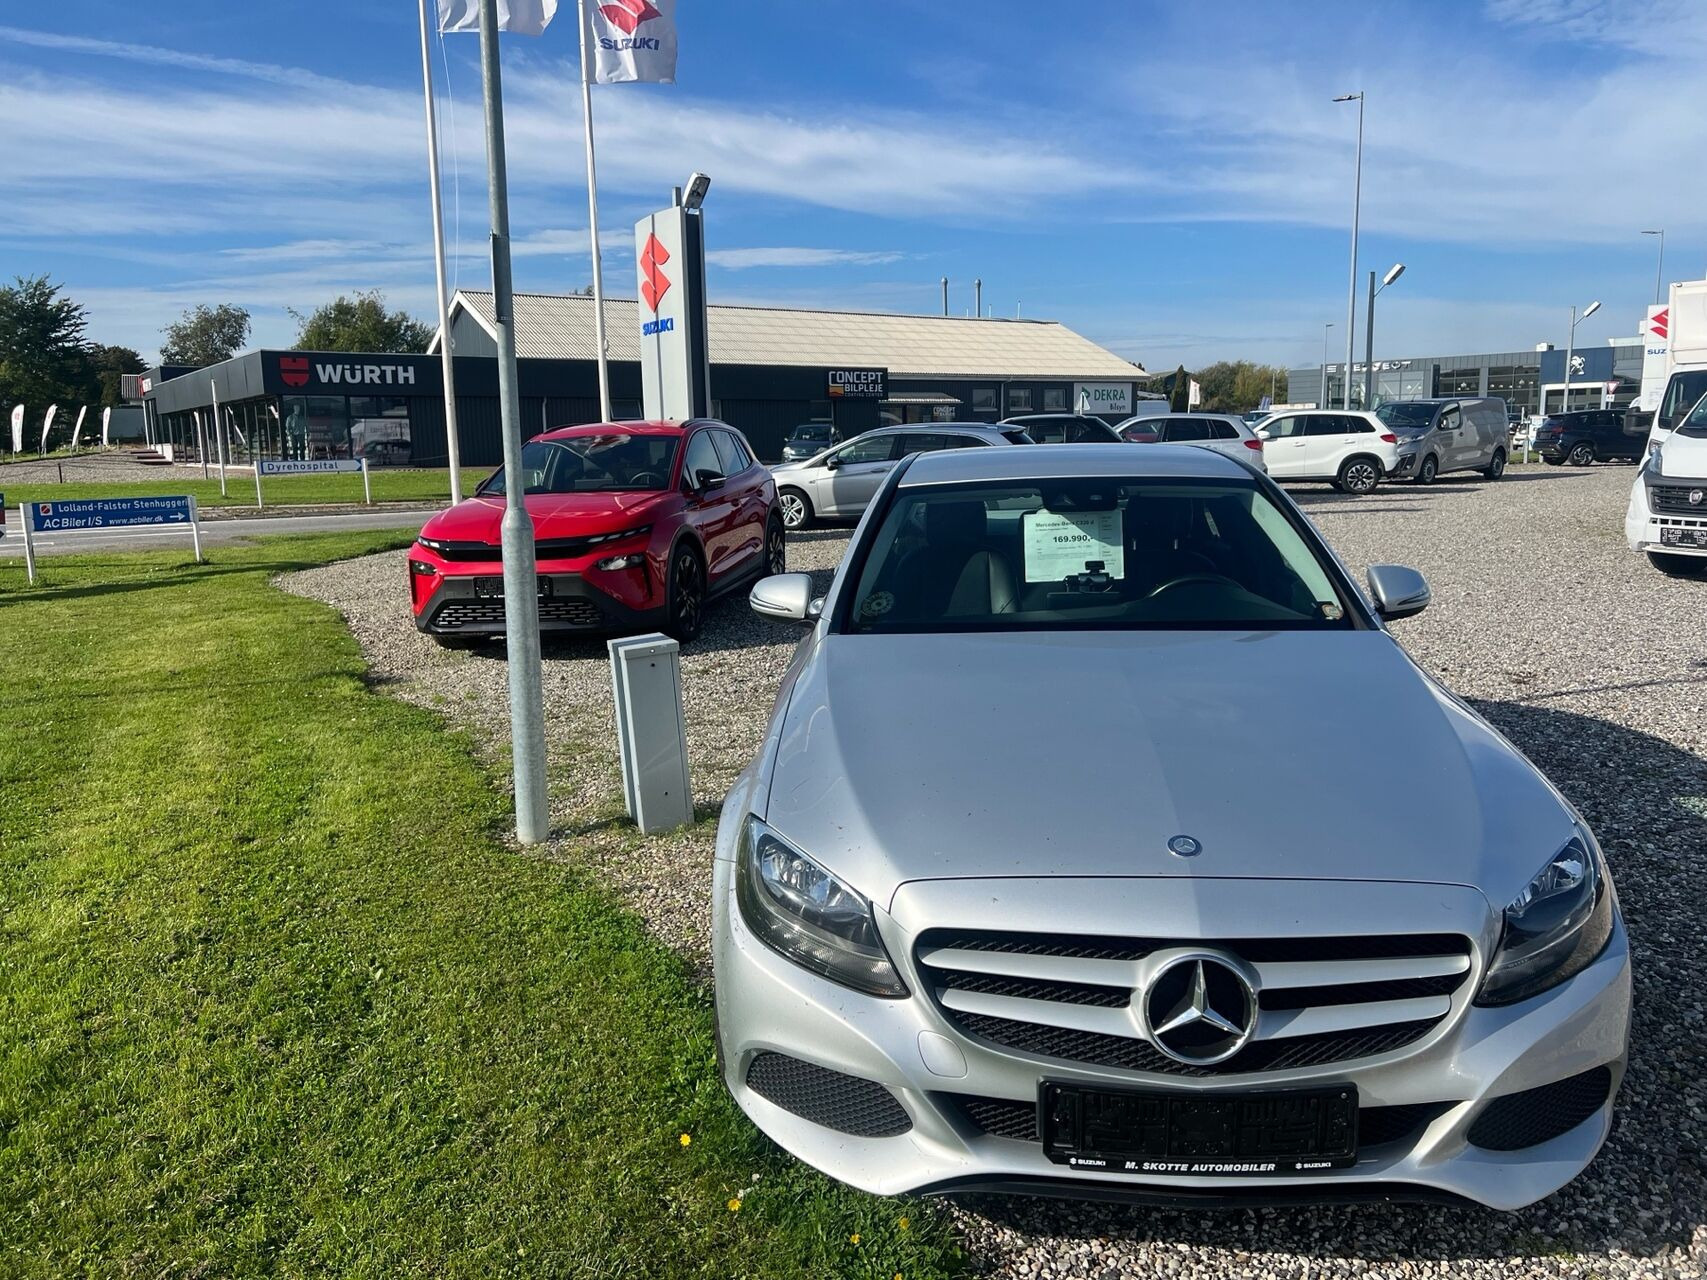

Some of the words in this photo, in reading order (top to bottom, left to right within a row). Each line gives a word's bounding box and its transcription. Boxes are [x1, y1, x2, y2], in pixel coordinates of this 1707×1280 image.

[600, 37, 660, 50] SUZUKI
[643, 317, 674, 336] SUZUKI
[315, 363, 415, 385] WÜRTH
[828, 371, 884, 386] CONCEPT
[844, 384, 884, 393] BILPLEJE
[1094, 389, 1126, 401] DEKRA
[267, 463, 339, 472] Dyrehospital
[58, 502, 131, 513] Lolland-Falster
[87, 516, 103, 527] I/S
[108, 515, 164, 525] www.acbiler.dk
[1125, 1161, 1139, 1169] M.
[1142, 1162, 1189, 1171] SKOTTE
[1191, 1163, 1276, 1172] AUTOMOBILER
[1303, 1161, 1332, 1169] SUZUKI
